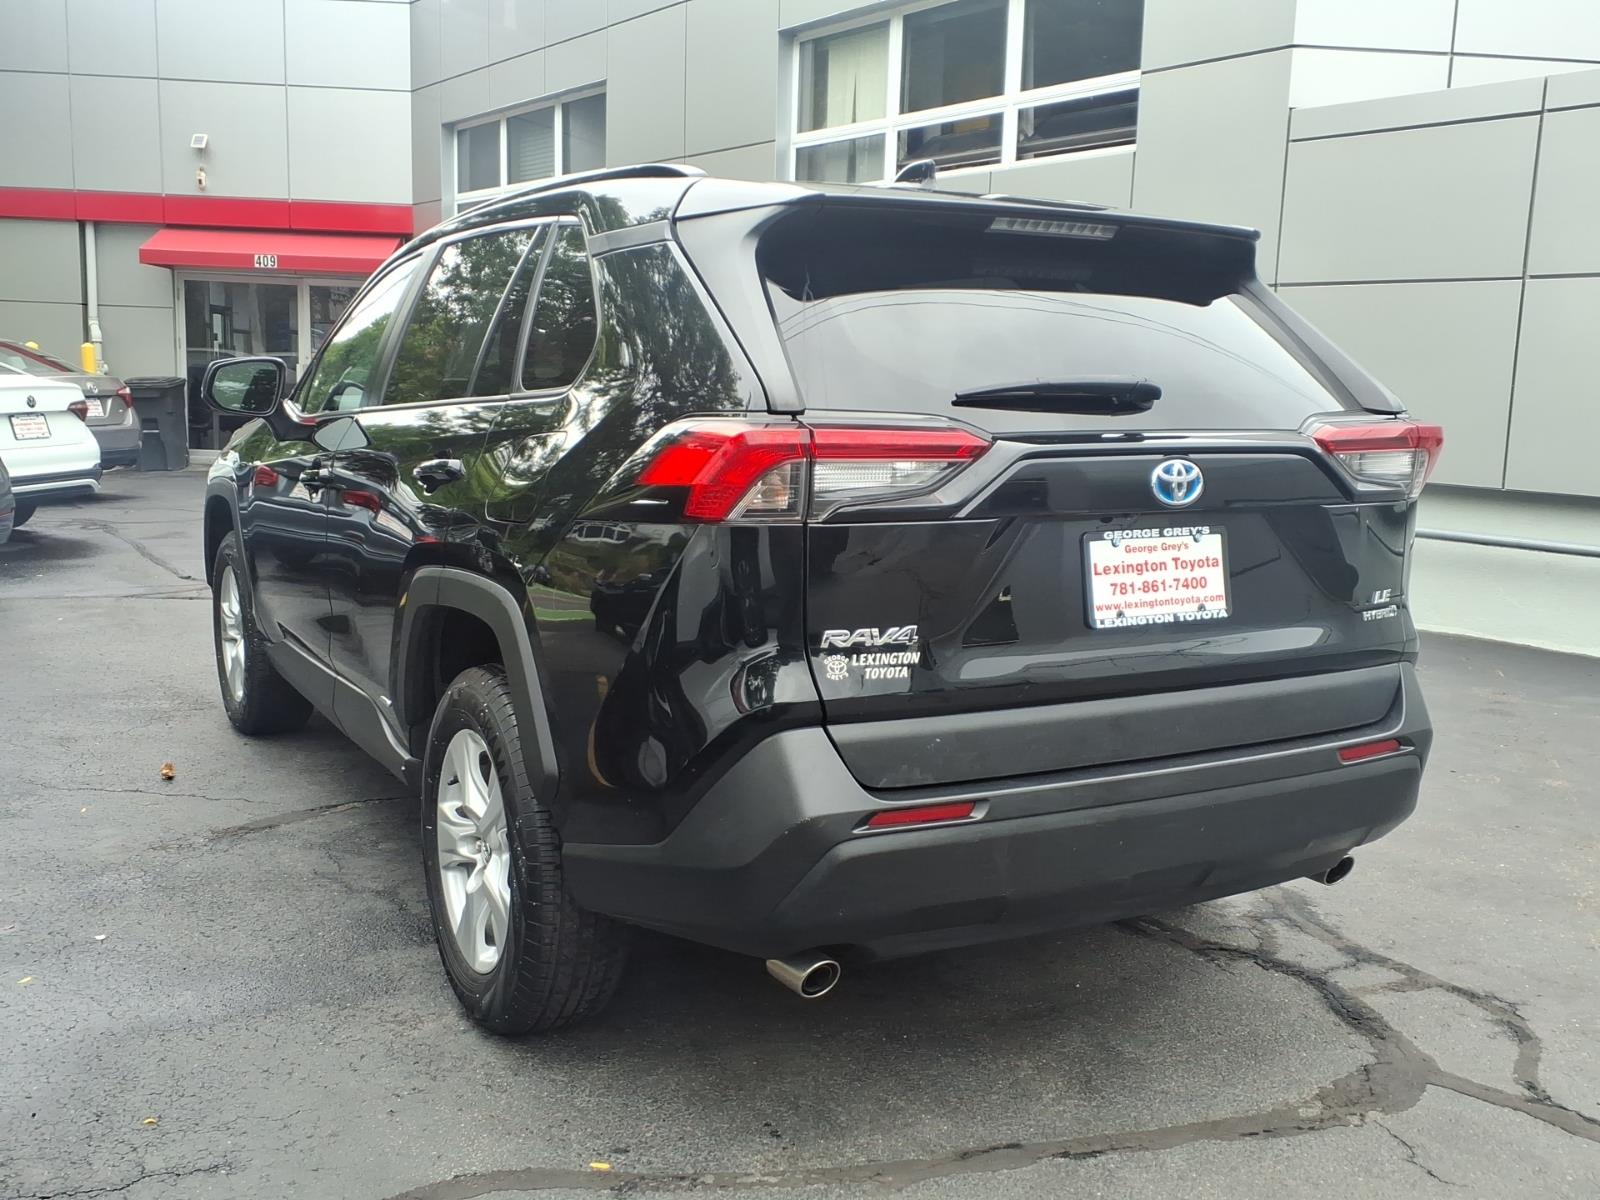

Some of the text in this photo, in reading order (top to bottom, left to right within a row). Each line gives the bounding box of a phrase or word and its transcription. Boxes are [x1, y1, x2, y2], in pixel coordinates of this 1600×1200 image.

[256, 255, 276, 267] 409
[1103, 526, 1210, 540] GEORGE GREY'S
[1124, 541, 1189, 554] George Grey's
[1093, 556, 1219, 576] Lexington Toyota
[1110, 576, 1207, 596] 781-861-7400
[1095, 593, 1224, 612] www.lexingtontoyota.com
[1374, 588, 1392, 604] LE
[1096, 608, 1228, 628] LEXINGTON TOYOTA
[820, 624, 919, 648] RAV4
[851, 652, 921, 666] LEXINGTON
[864, 666, 908, 679] TOYOTA
